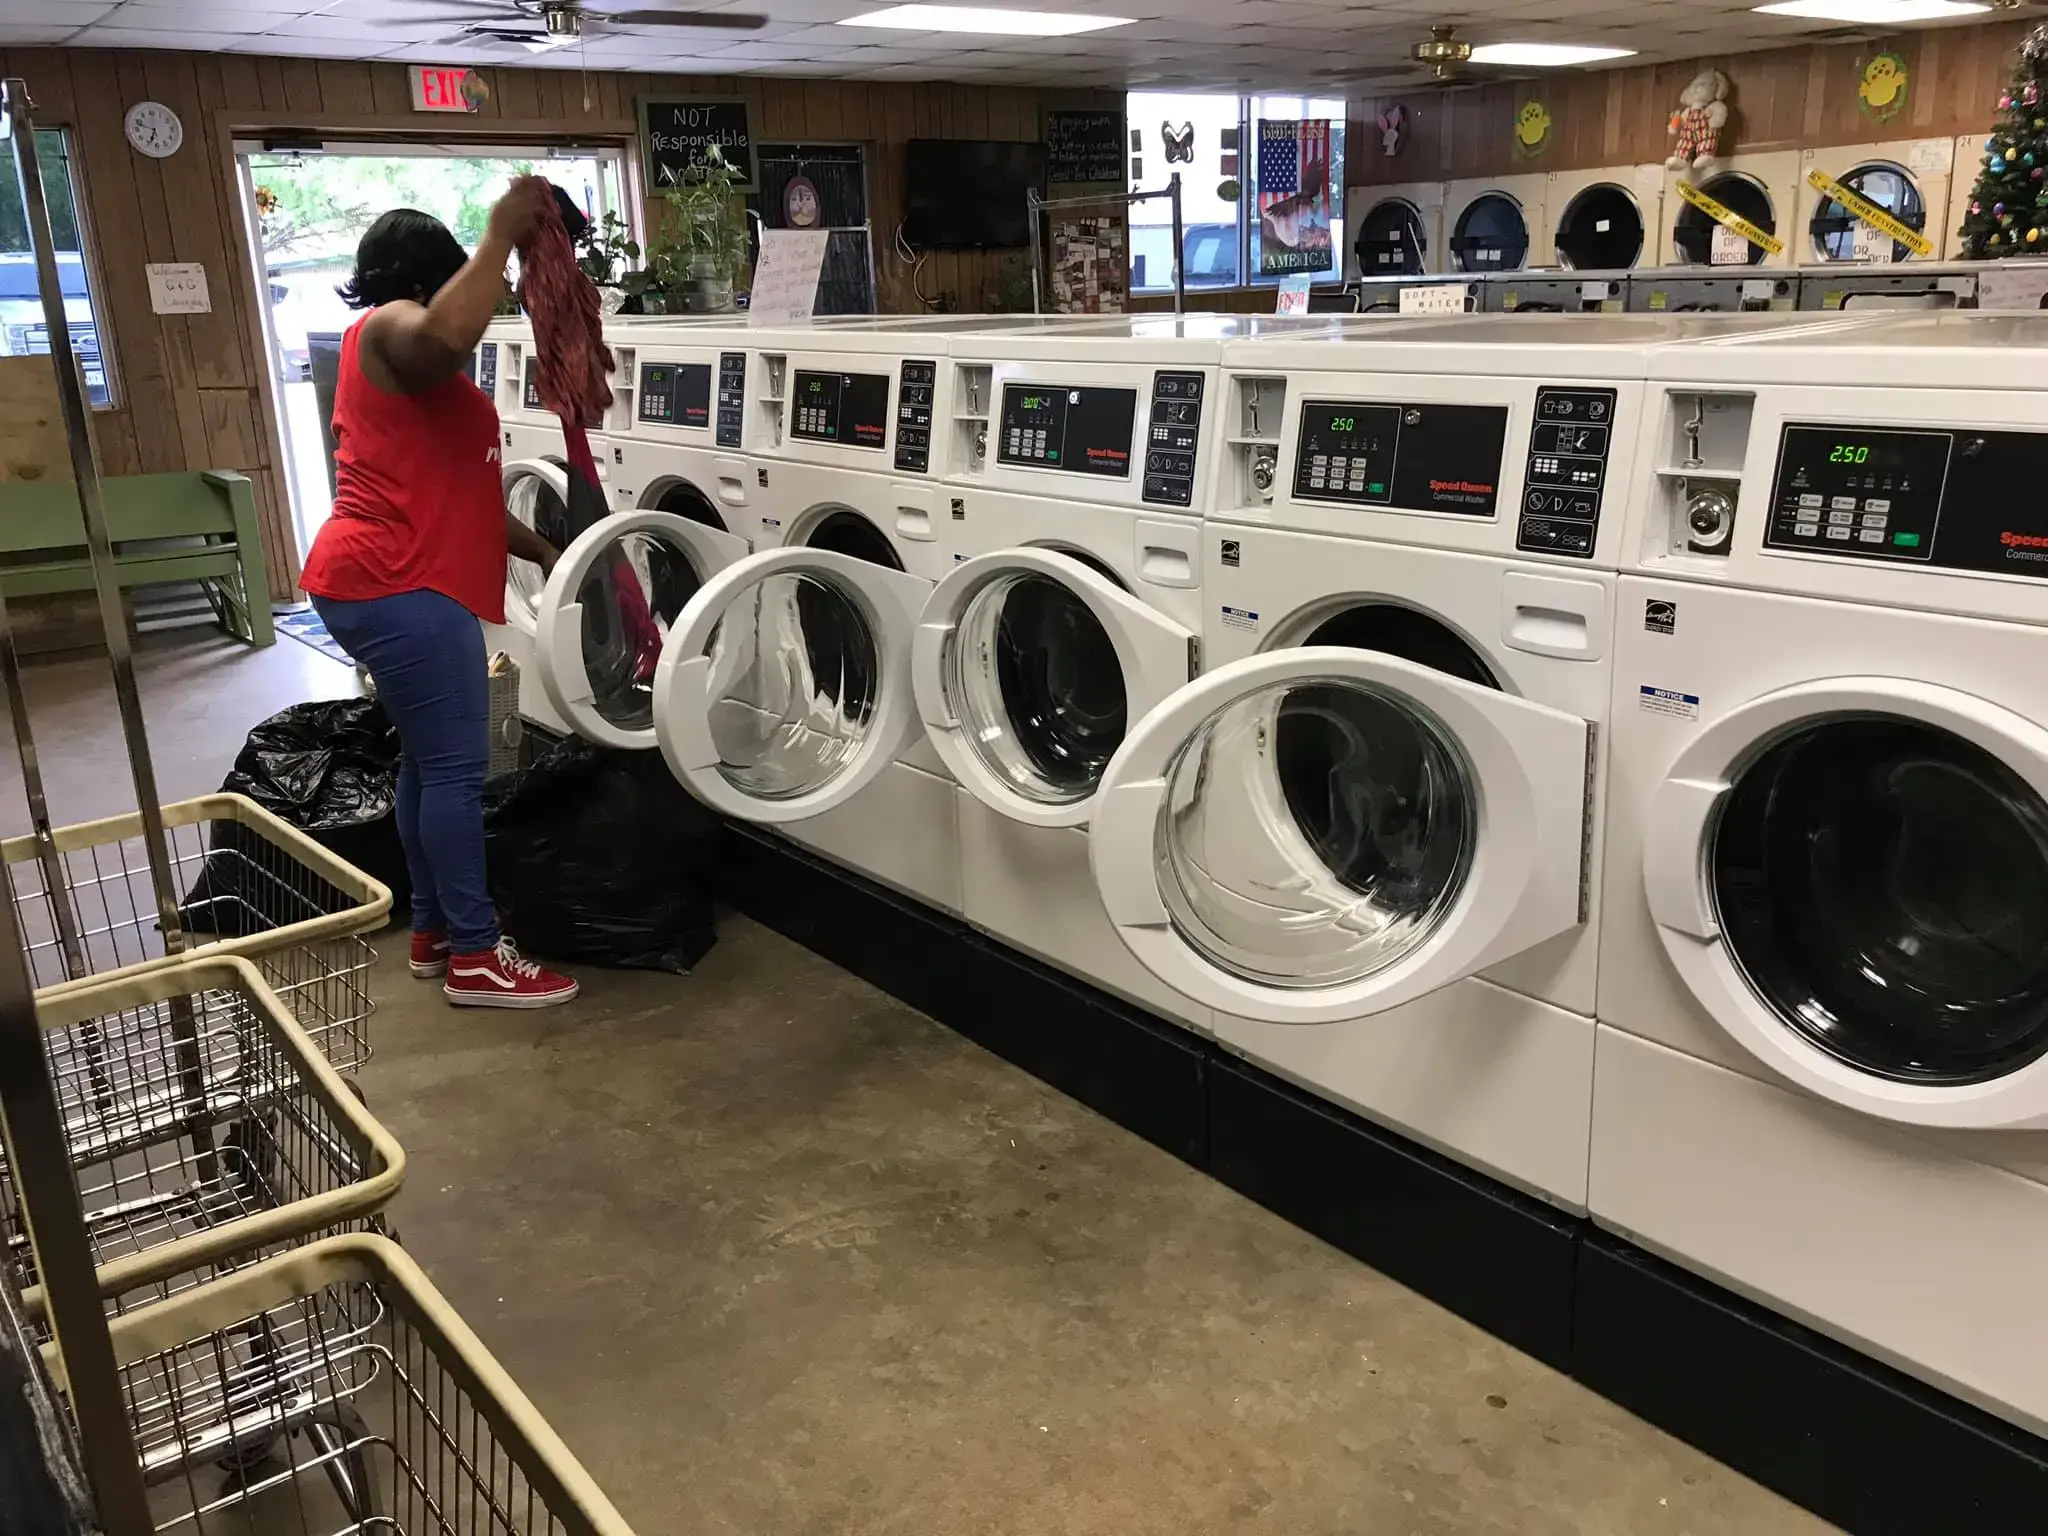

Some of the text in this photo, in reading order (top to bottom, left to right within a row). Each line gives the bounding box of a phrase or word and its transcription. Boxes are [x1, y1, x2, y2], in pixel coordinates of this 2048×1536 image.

[673, 105, 716, 128] NOT
[1866, 229, 1880, 241] OF
[1266, 251, 1330, 269] AMERICA
[1712, 252, 1747, 262] ORDER
[1418, 298, 1460, 308] WATER
[1331, 417, 1354, 431] 2.50
[1830, 446, 1868, 463] 2.50
[1429, 480, 1460, 491] Speed
[1654, 689, 1684, 701] NOTICE
